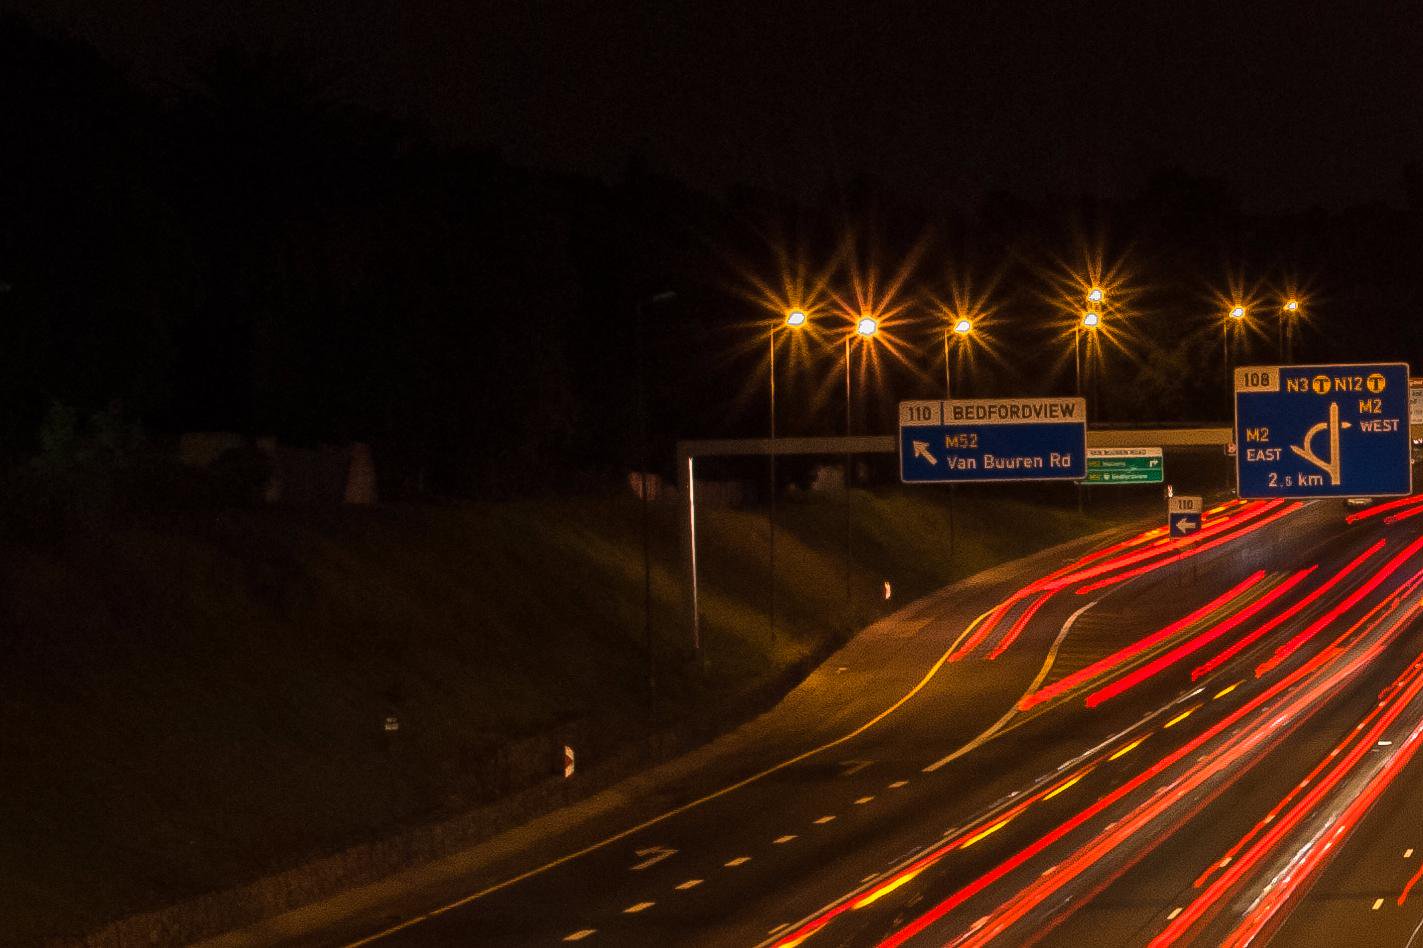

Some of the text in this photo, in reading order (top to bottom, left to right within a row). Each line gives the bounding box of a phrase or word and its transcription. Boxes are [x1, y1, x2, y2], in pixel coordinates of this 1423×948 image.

[1244, 373, 1270, 387] 108
[1287, 378, 1309, 393] N3
[1335, 377, 1363, 392] N12
[908, 403, 1075, 421] 110 BEDFORDVIEW
[1359, 399, 1382, 414] M2
[1359, 419, 1400, 433] WEST
[945, 434, 977, 449] M52
[1246, 428, 1269, 442] M2
[947, 452, 1071, 470] Van Buuren Rd
[1247, 449, 1282, 461] EAST
[1298, 472, 1323, 486] km
